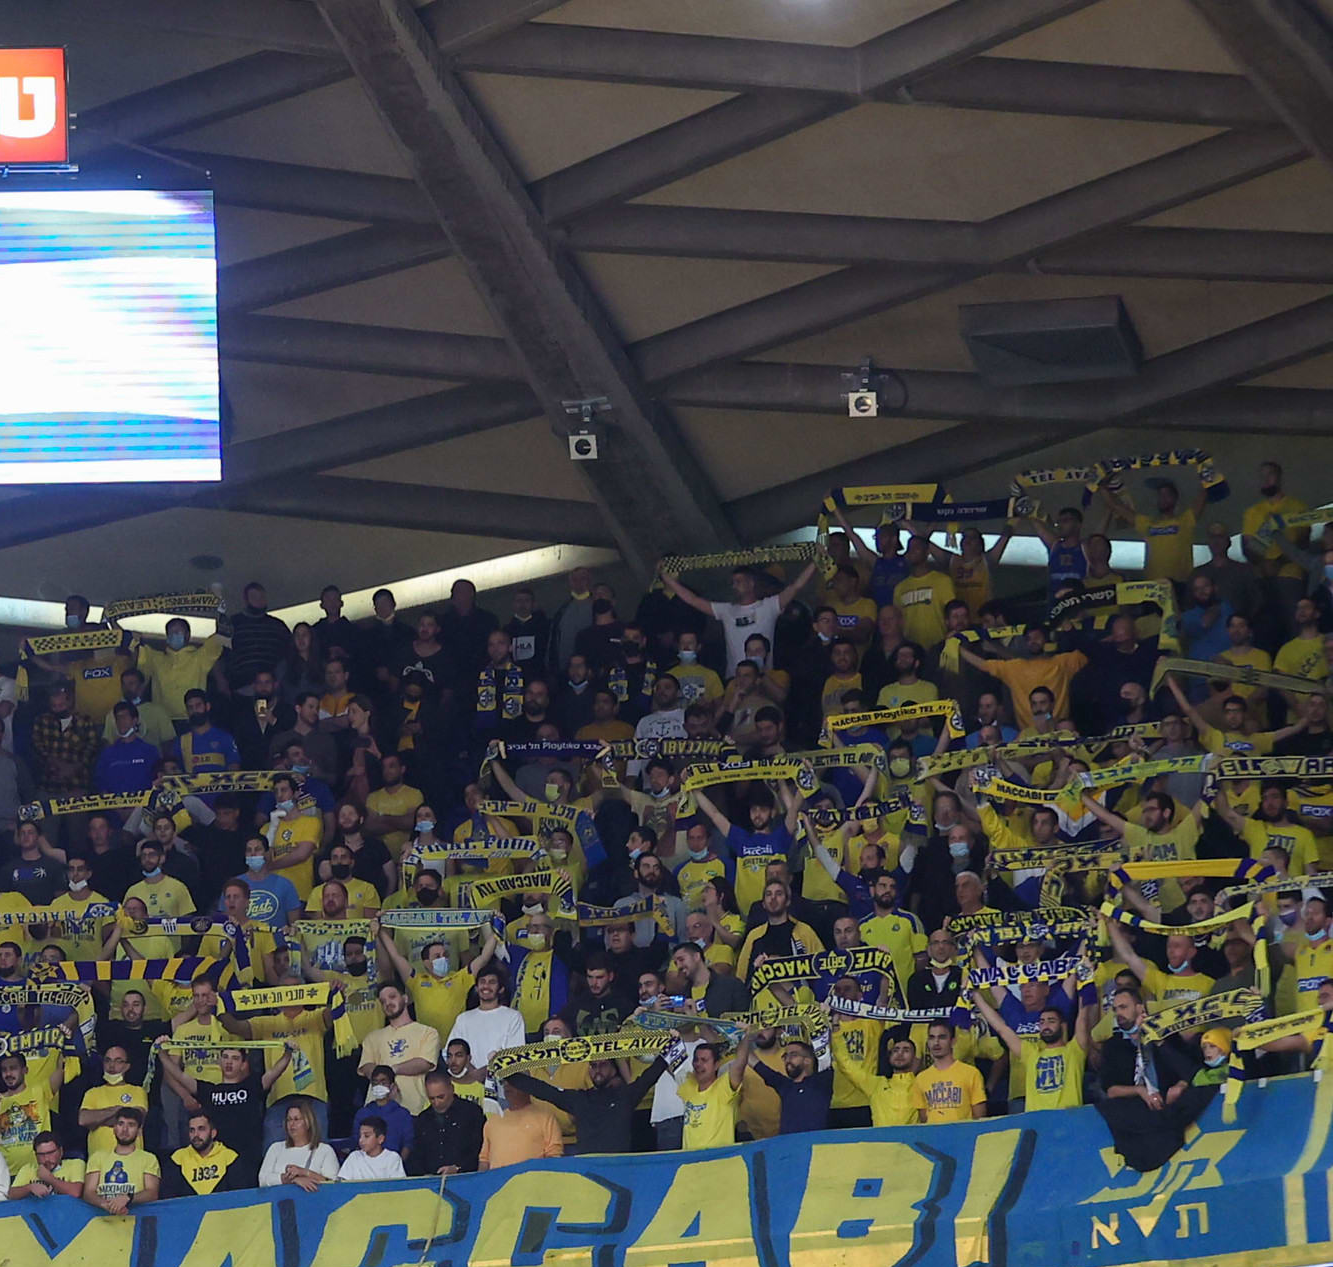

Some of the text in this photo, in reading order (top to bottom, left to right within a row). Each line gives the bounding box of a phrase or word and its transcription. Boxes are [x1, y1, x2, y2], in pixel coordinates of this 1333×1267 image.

[83, 668, 110, 679] FOX
[832, 707, 917, 727] MACCABI Playtika
[721, 761, 751, 770] FOX
[996, 783, 1042, 799] MACCABI
[1302, 805, 1332, 817] FOX
[498, 873, 552, 895] MACCABI
[854, 951, 892, 971] GATE
[594, 1036, 673, 1052] TEL-AVIV
[211, 1088, 248, 1102] HUGO
[924, 1089, 963, 1105] MACCABI
[193, 1165, 219, 1181] 1932
